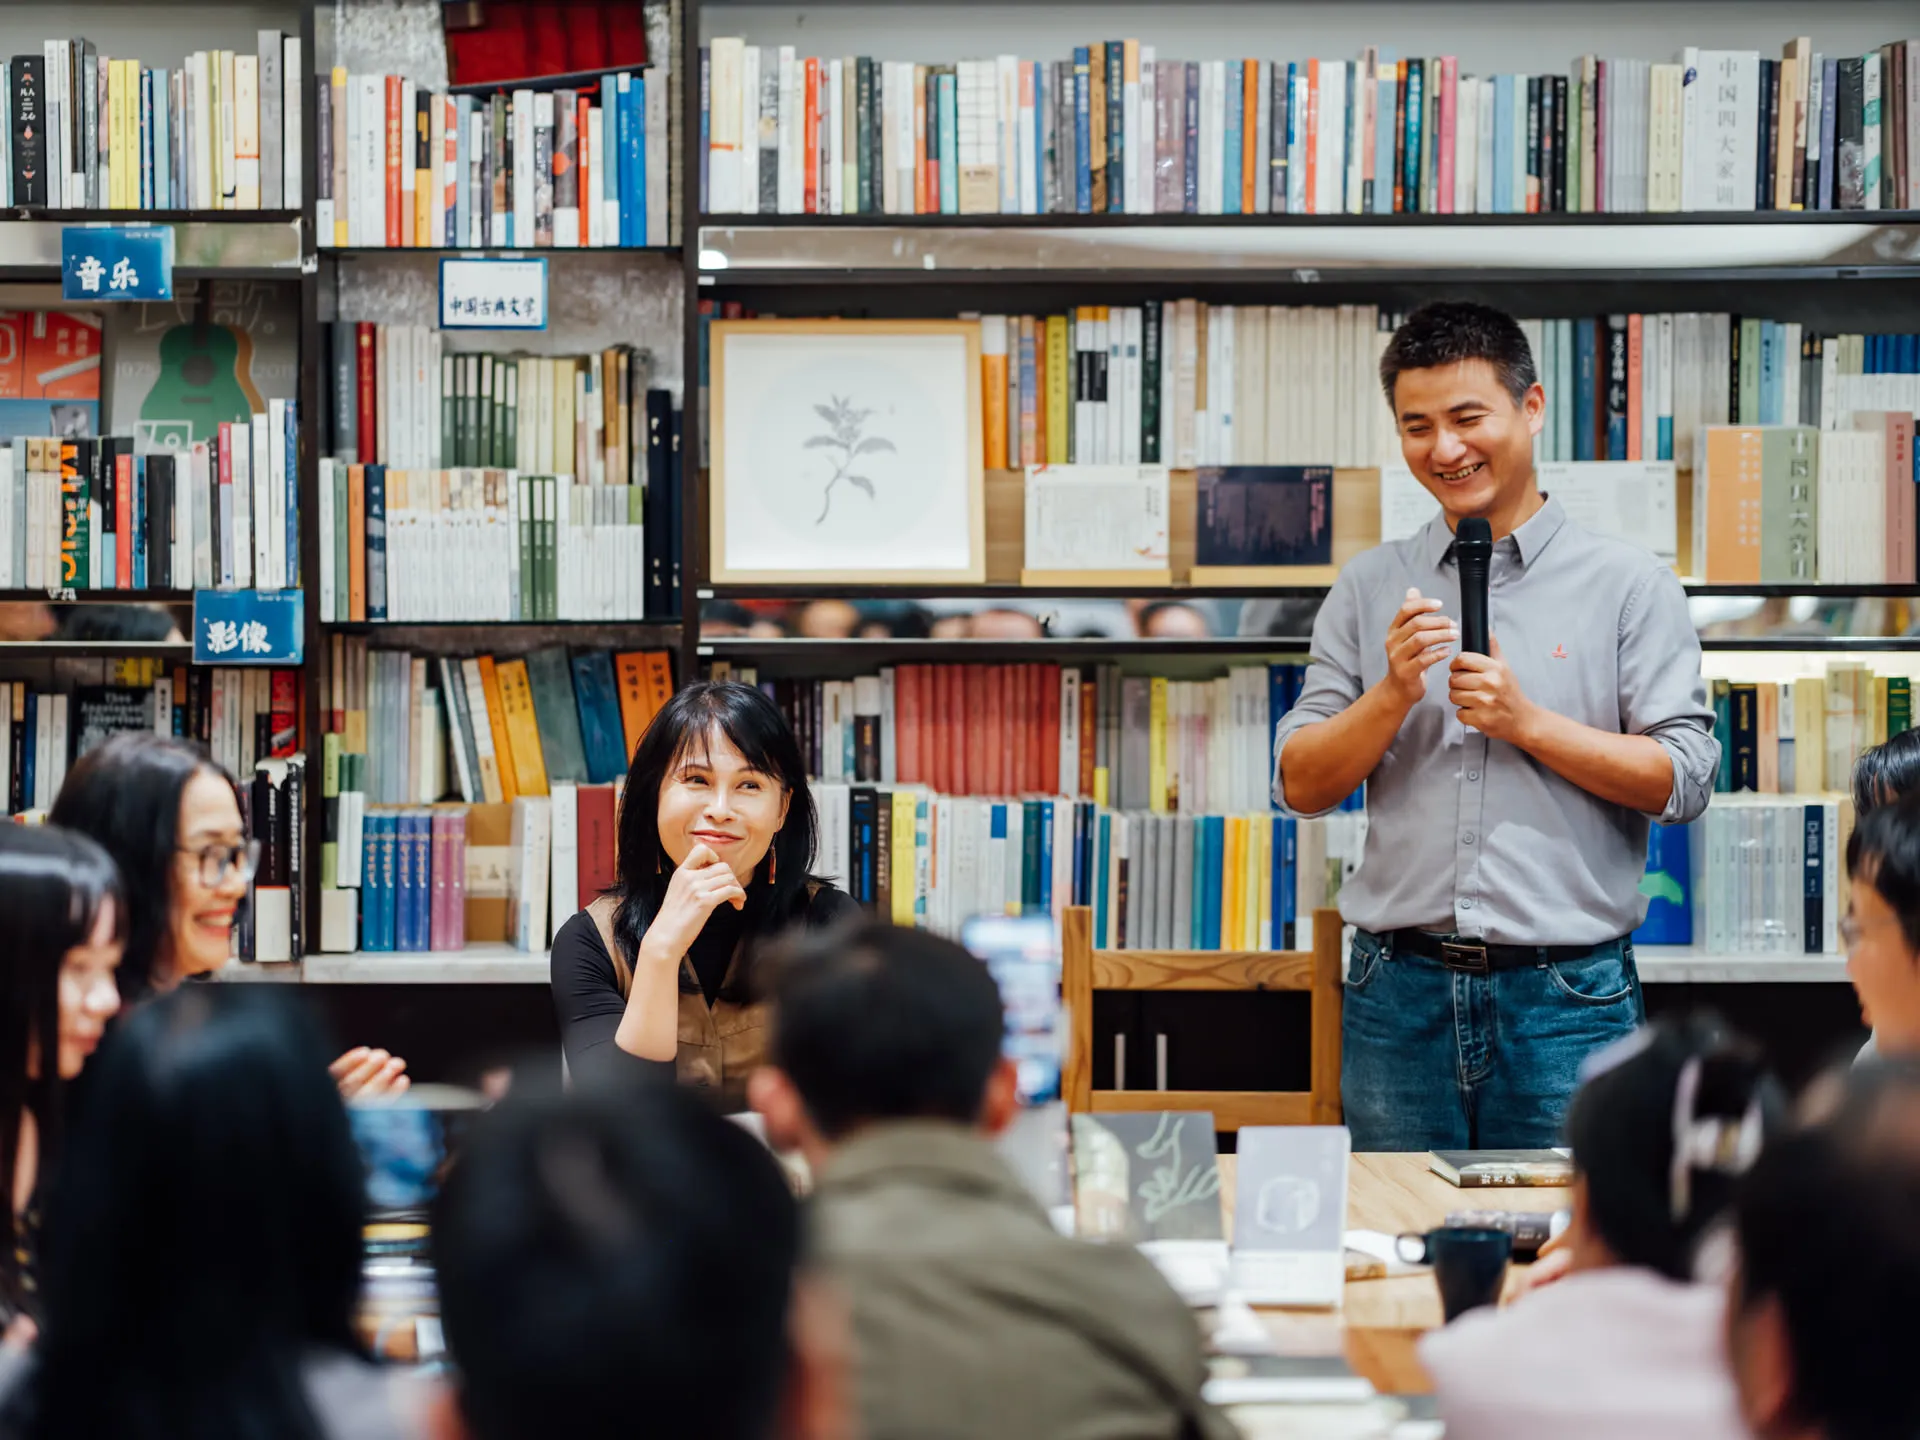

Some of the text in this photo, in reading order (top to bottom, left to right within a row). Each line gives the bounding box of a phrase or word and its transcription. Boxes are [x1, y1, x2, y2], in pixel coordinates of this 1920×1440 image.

[75, 255, 139, 292] 音乐
[449, 295, 535, 318] 中国古典文学
[207, 620, 272, 654] 影像
